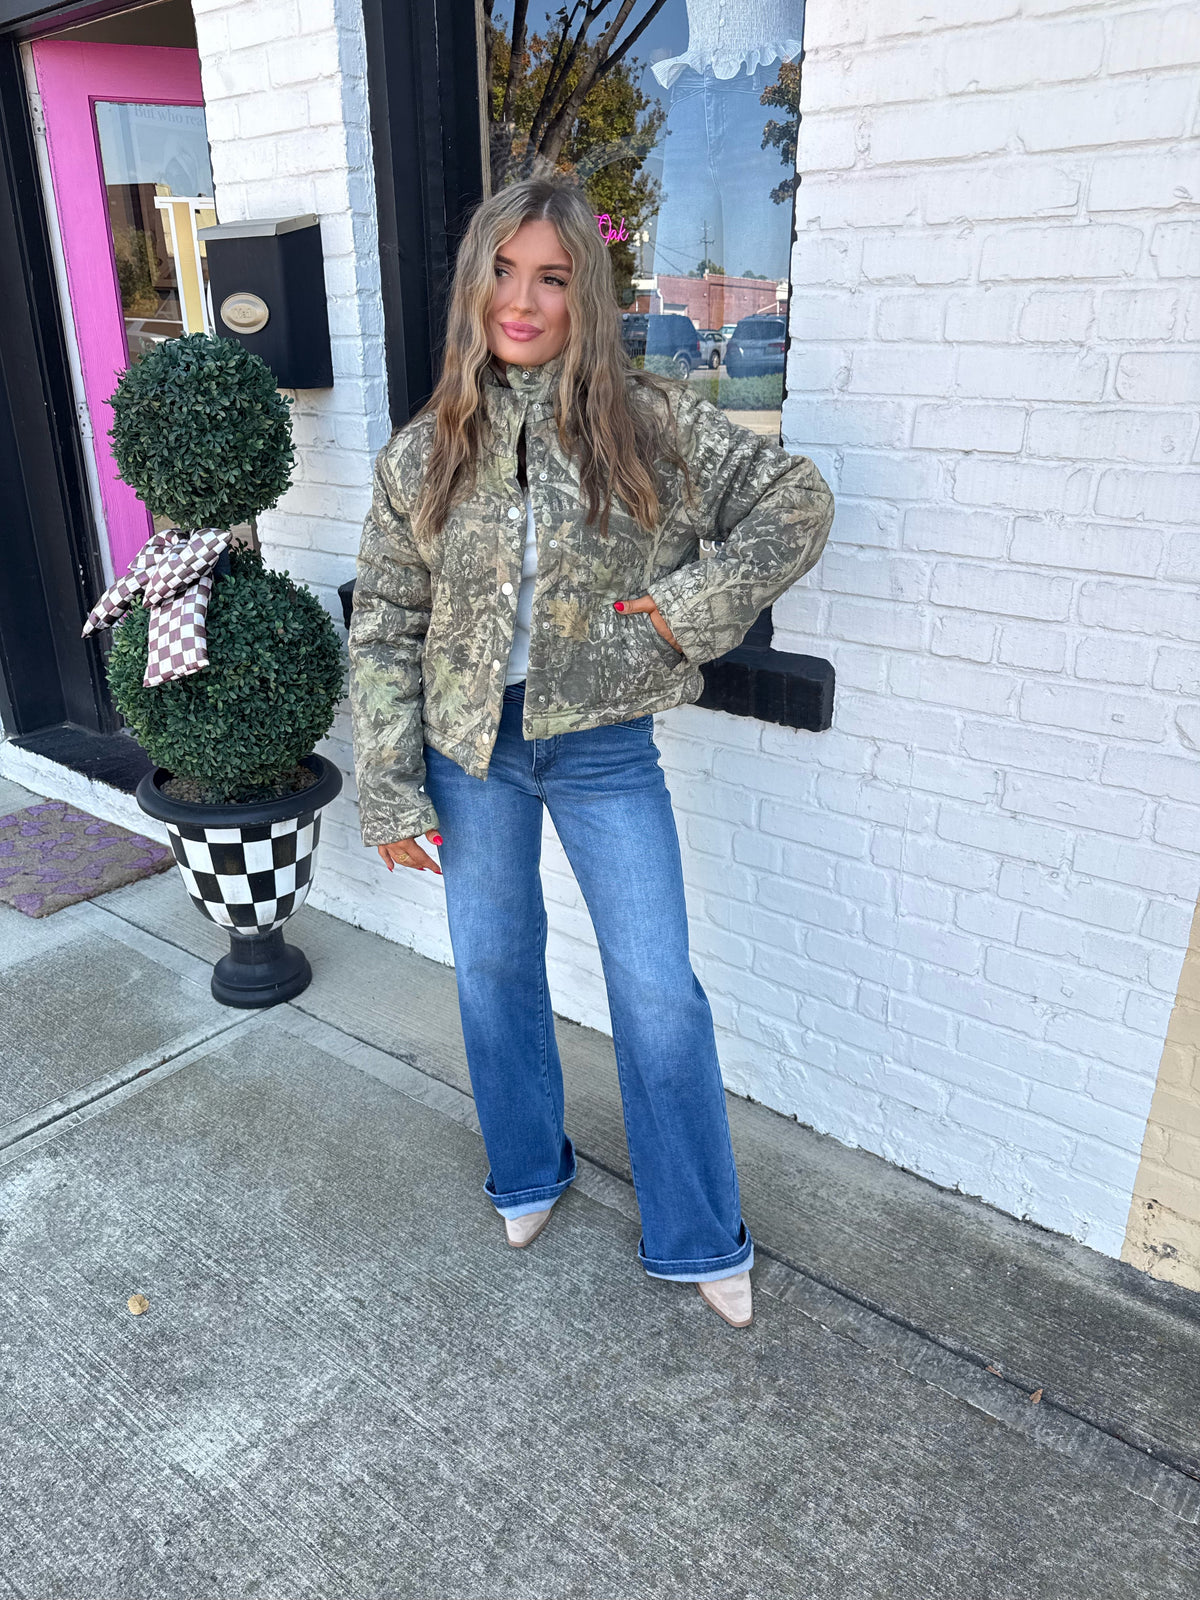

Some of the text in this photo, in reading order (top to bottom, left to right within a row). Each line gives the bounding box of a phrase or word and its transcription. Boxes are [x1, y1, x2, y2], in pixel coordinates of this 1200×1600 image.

[135, 105, 155, 119] But
[158, 108, 183, 124] who
[593, 213, 630, 246] Oak
